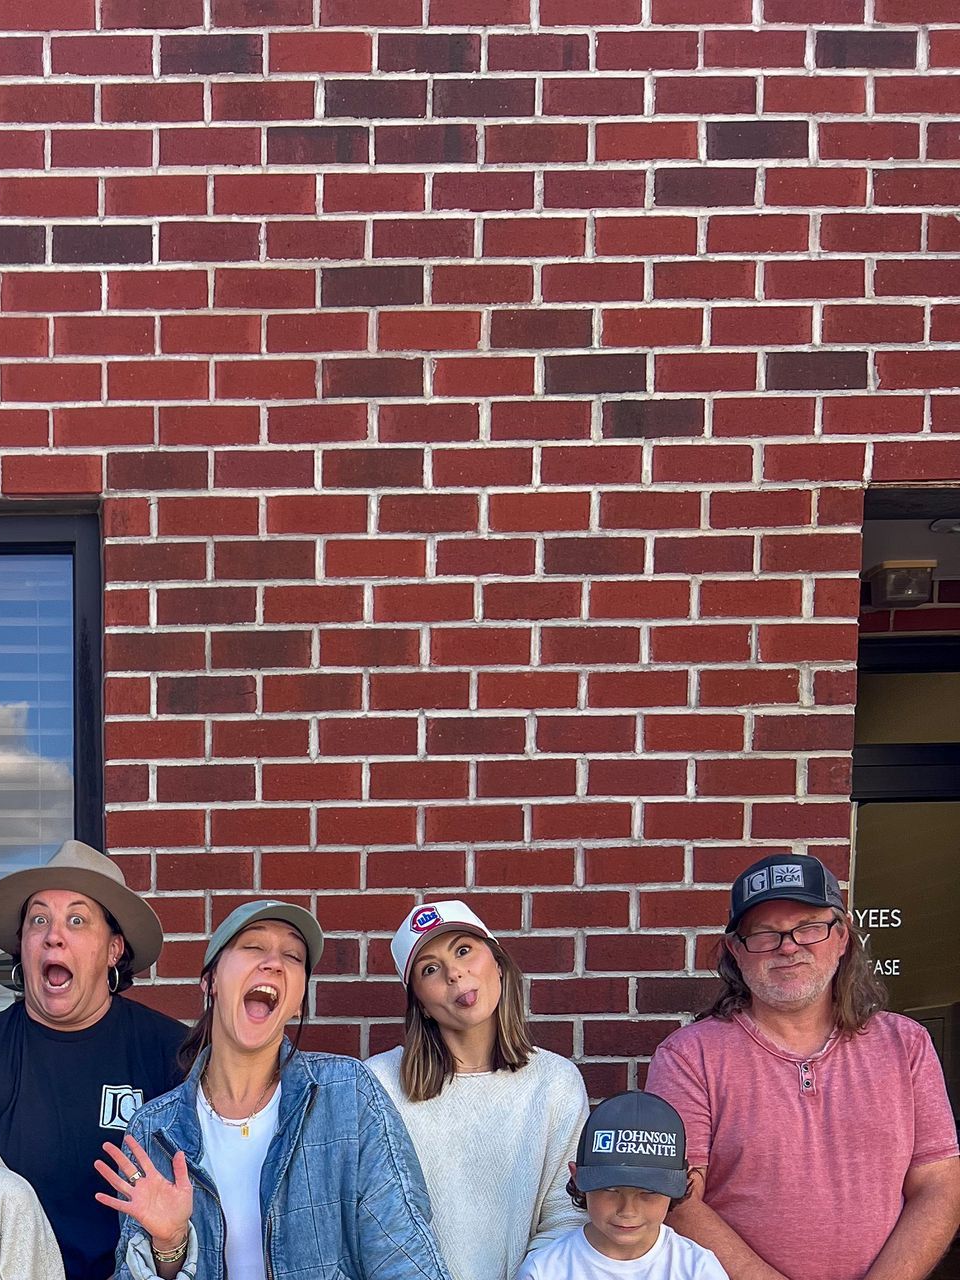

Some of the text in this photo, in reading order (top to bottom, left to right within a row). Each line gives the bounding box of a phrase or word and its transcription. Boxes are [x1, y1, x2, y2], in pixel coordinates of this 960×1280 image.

[775, 874, 800, 884] BGM
[867, 959, 900, 976] ASE
[617, 1129, 677, 1145] JOHNSON
[615, 1142, 677, 1157] GRANITE
